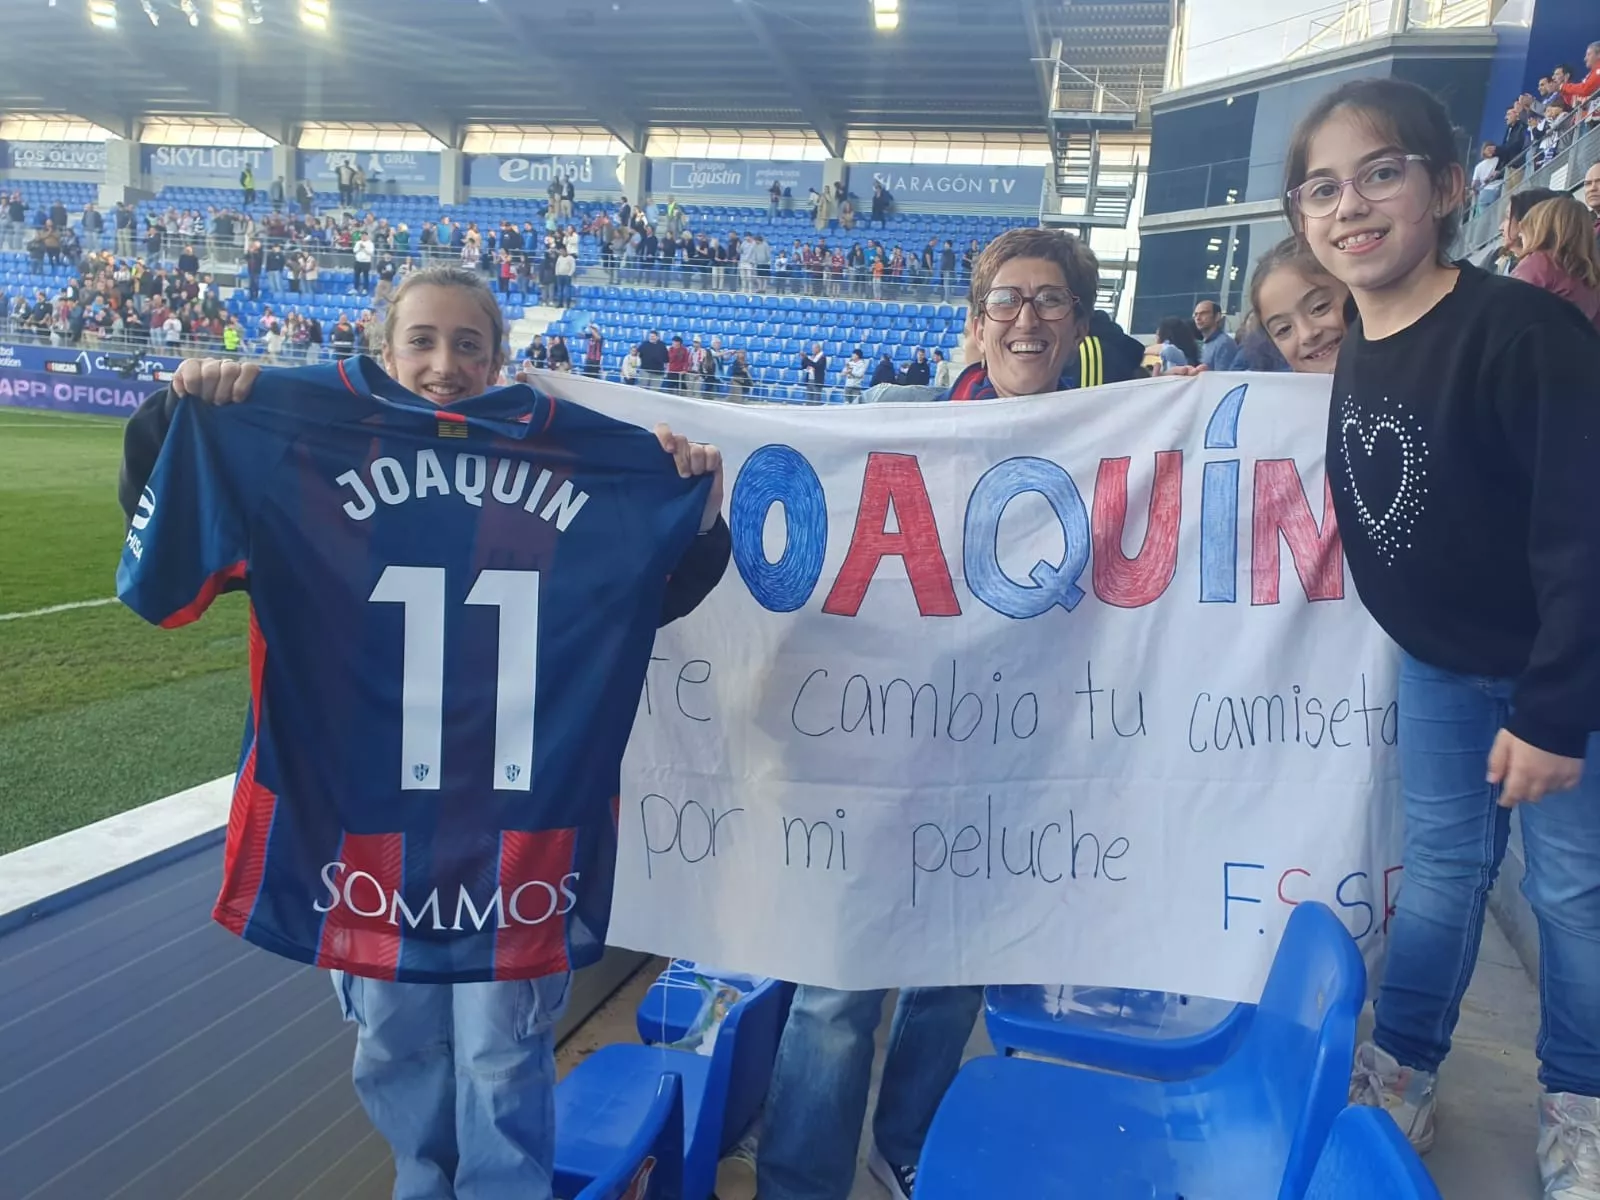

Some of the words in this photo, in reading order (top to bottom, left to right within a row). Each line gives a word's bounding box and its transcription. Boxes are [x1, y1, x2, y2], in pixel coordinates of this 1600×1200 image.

[14, 150, 46, 161] LOS
[156, 147, 264, 169] SKYLIGHT
[894, 173, 983, 194] ARAGÓN
[989, 179, 1016, 194] TV
[0, 378, 46, 400] APP
[335, 448, 590, 533] JOAQUIN
[730, 384, 1345, 619] OAQUÍN
[368, 565, 540, 791] 11
[791, 659, 1039, 745] cambio
[1074, 660, 1147, 740] tu
[1188, 673, 1399, 753] camiseta
[640, 794, 745, 879] por
[782, 808, 847, 870] mi
[912, 794, 1130, 908] peluche
[312, 861, 581, 931] SOMMOS
